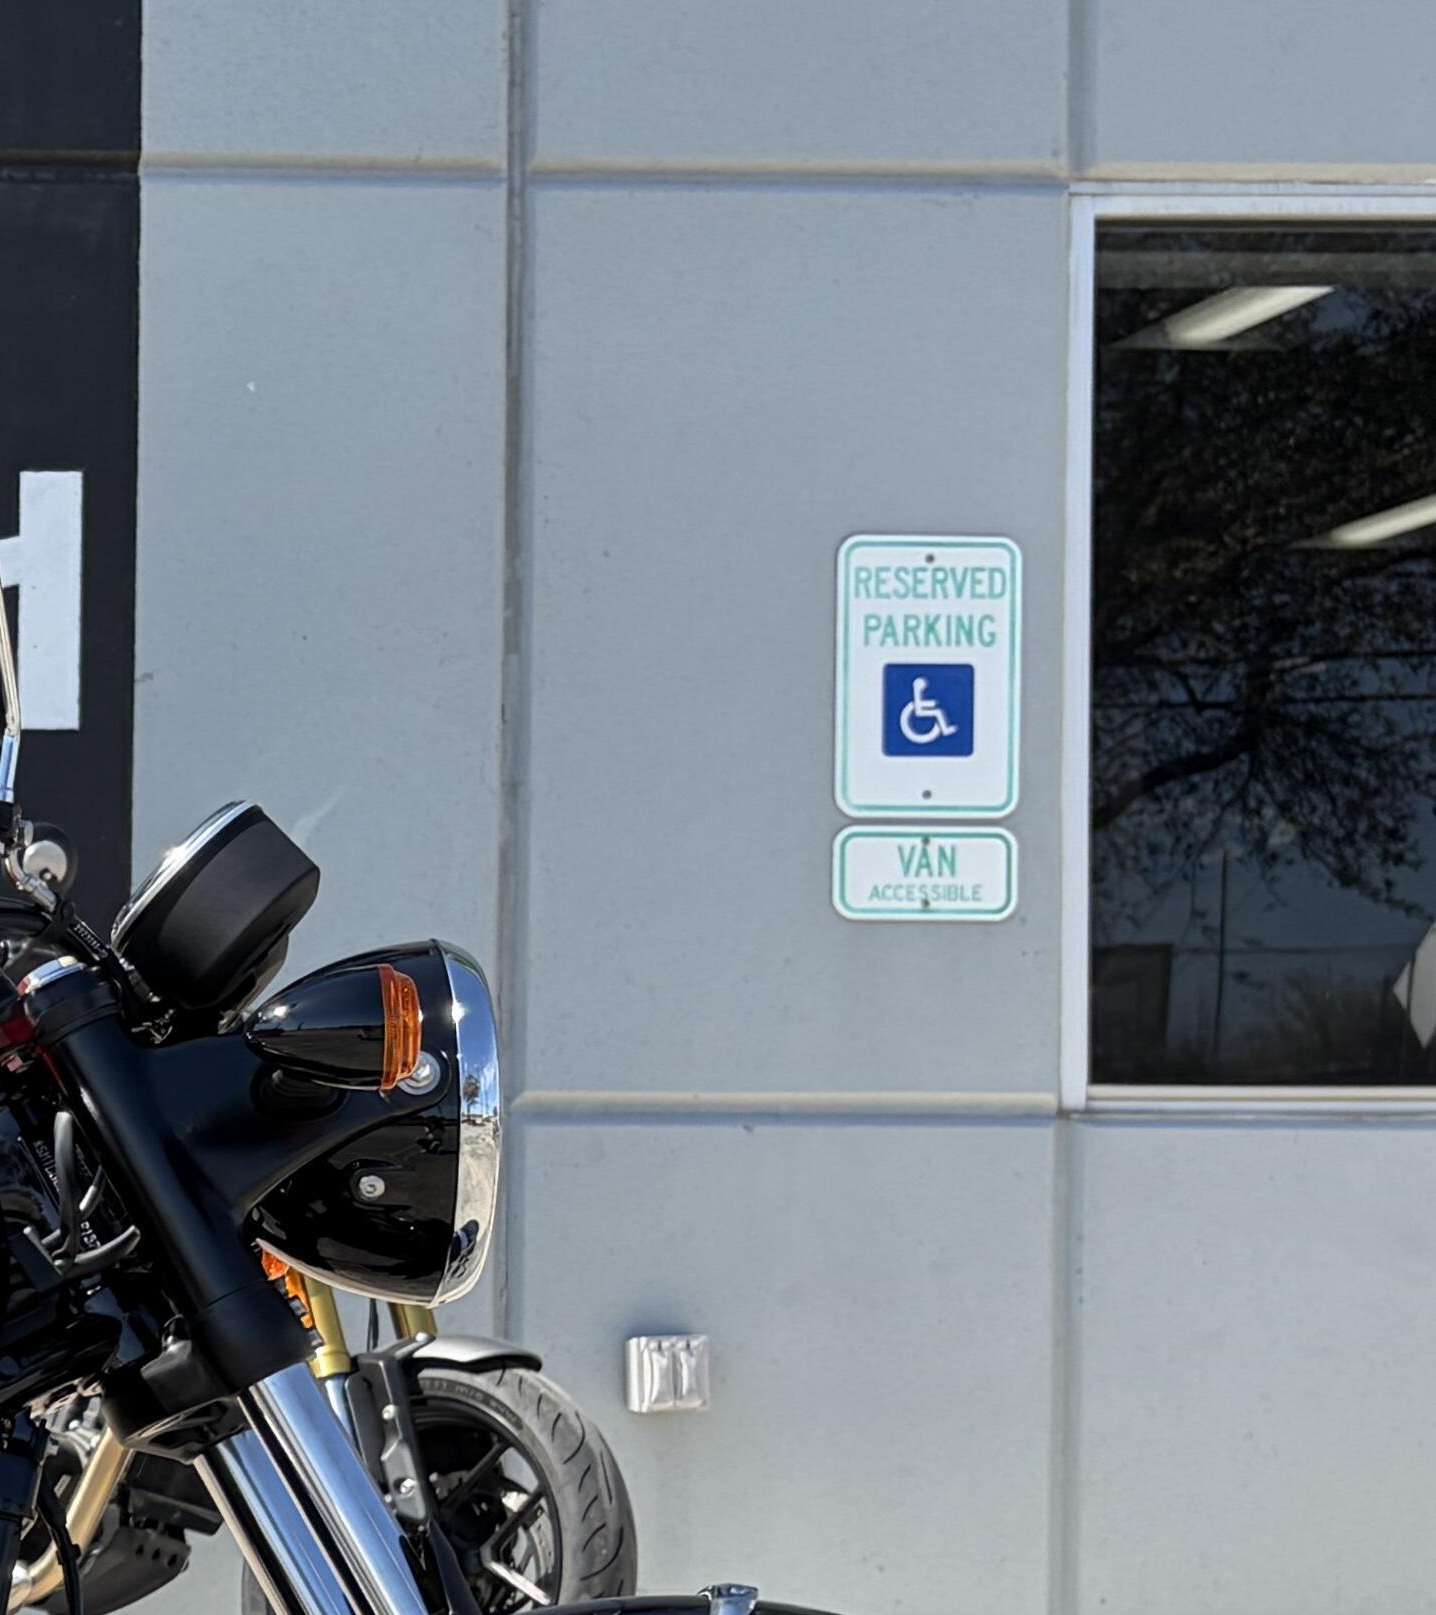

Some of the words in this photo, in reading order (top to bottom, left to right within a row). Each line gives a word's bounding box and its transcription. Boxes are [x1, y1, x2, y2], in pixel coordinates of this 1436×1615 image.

[854, 567, 1007, 600] RESERVED
[863, 614, 996, 648] PARKING
[897, 845, 957, 877] VAN
[868, 884, 983, 902] ACCESSIBLE
